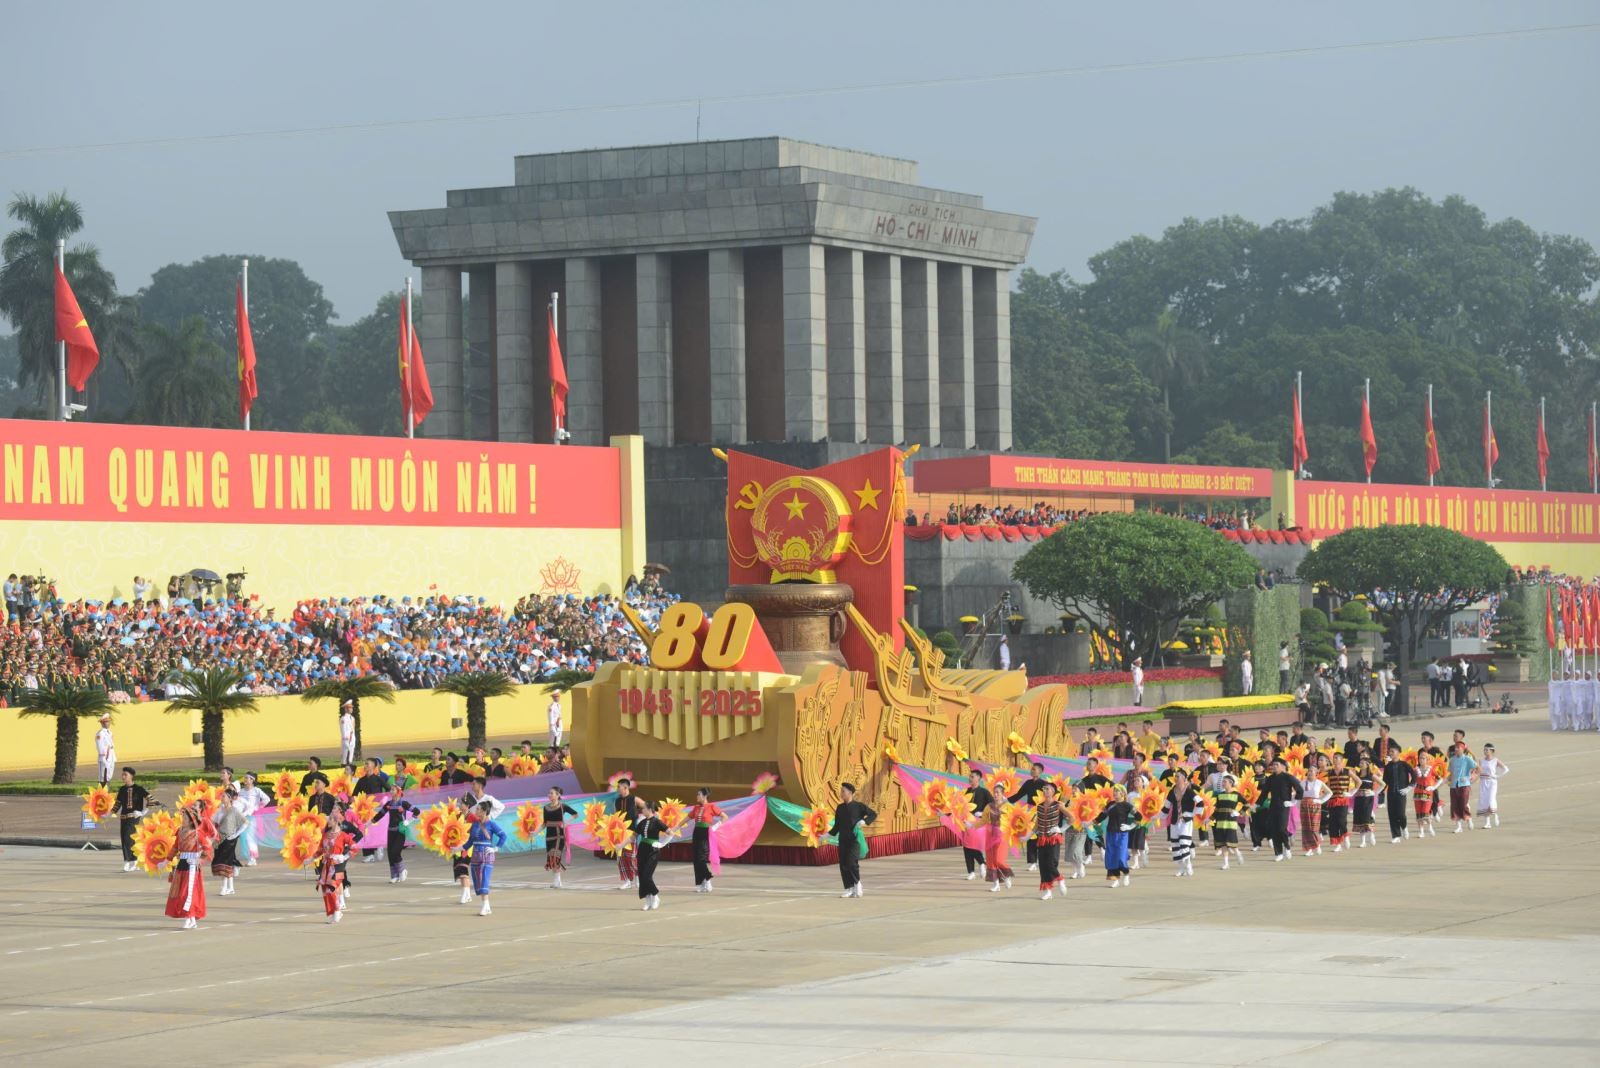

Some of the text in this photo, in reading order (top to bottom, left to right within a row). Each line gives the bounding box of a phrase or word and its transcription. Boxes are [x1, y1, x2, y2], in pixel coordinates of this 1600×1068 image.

[4, 443, 85, 505] NAM
[108, 447, 230, 513] QUANG
[250, 453, 331, 510] VINH
[350, 449, 438, 512] MUÔN
[457, 453, 517, 514] NĂM
[1308, 488, 1345, 530] NƯỚC
[1503, 497, 1537, 533] NGHĨA
[1542, 498, 1566, 539] VIỆT
[1571, 503, 1593, 535] NAM
[651, 602, 756, 669] 80
[618, 688, 673, 715] 1945
[701, 690, 762, 716] 2025
